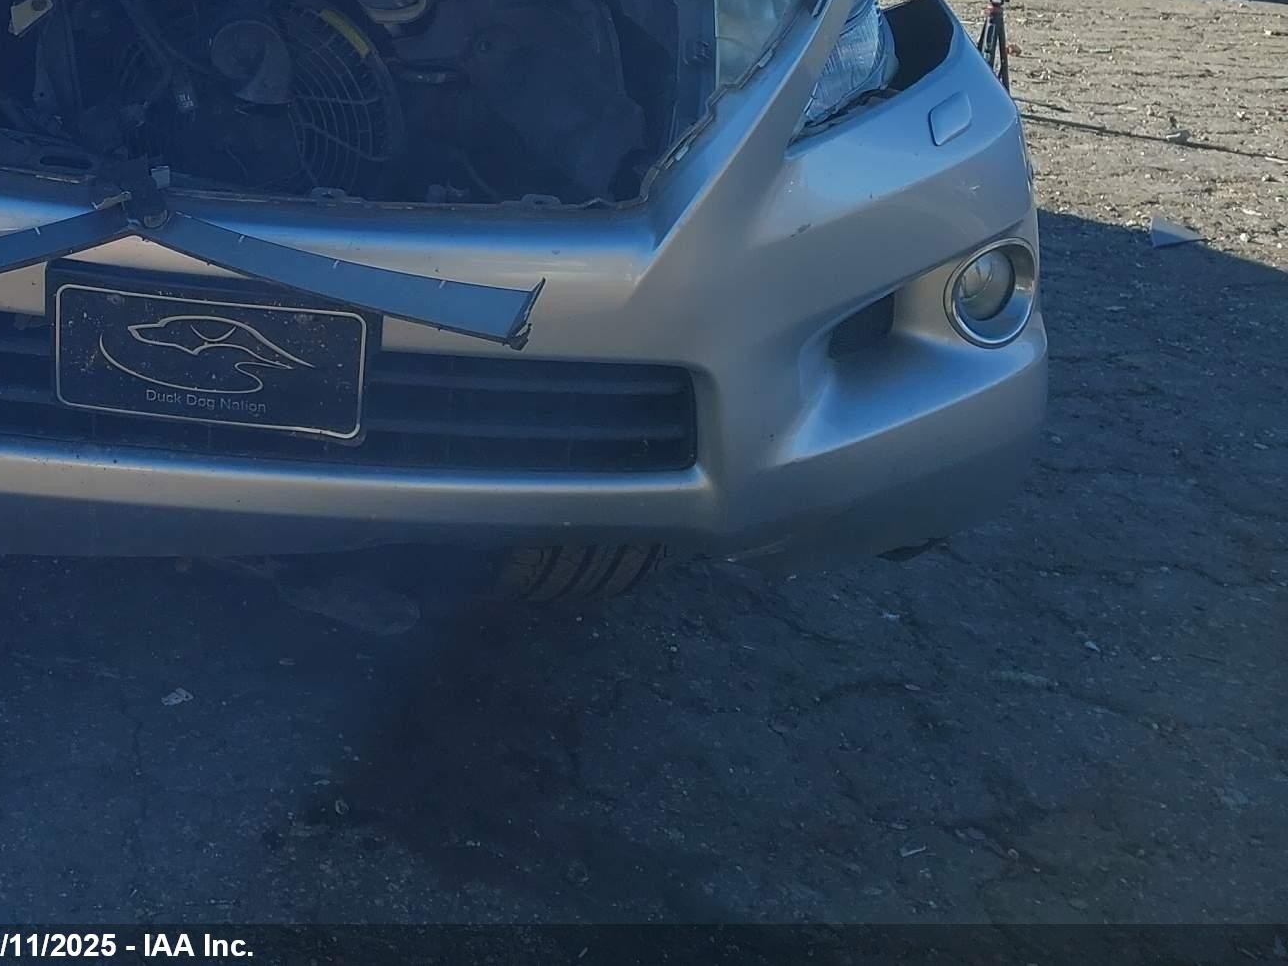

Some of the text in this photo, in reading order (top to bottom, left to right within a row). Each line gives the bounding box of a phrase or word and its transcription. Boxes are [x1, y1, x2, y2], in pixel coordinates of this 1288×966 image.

[145, 389, 267, 413] Duck Dog Nation
